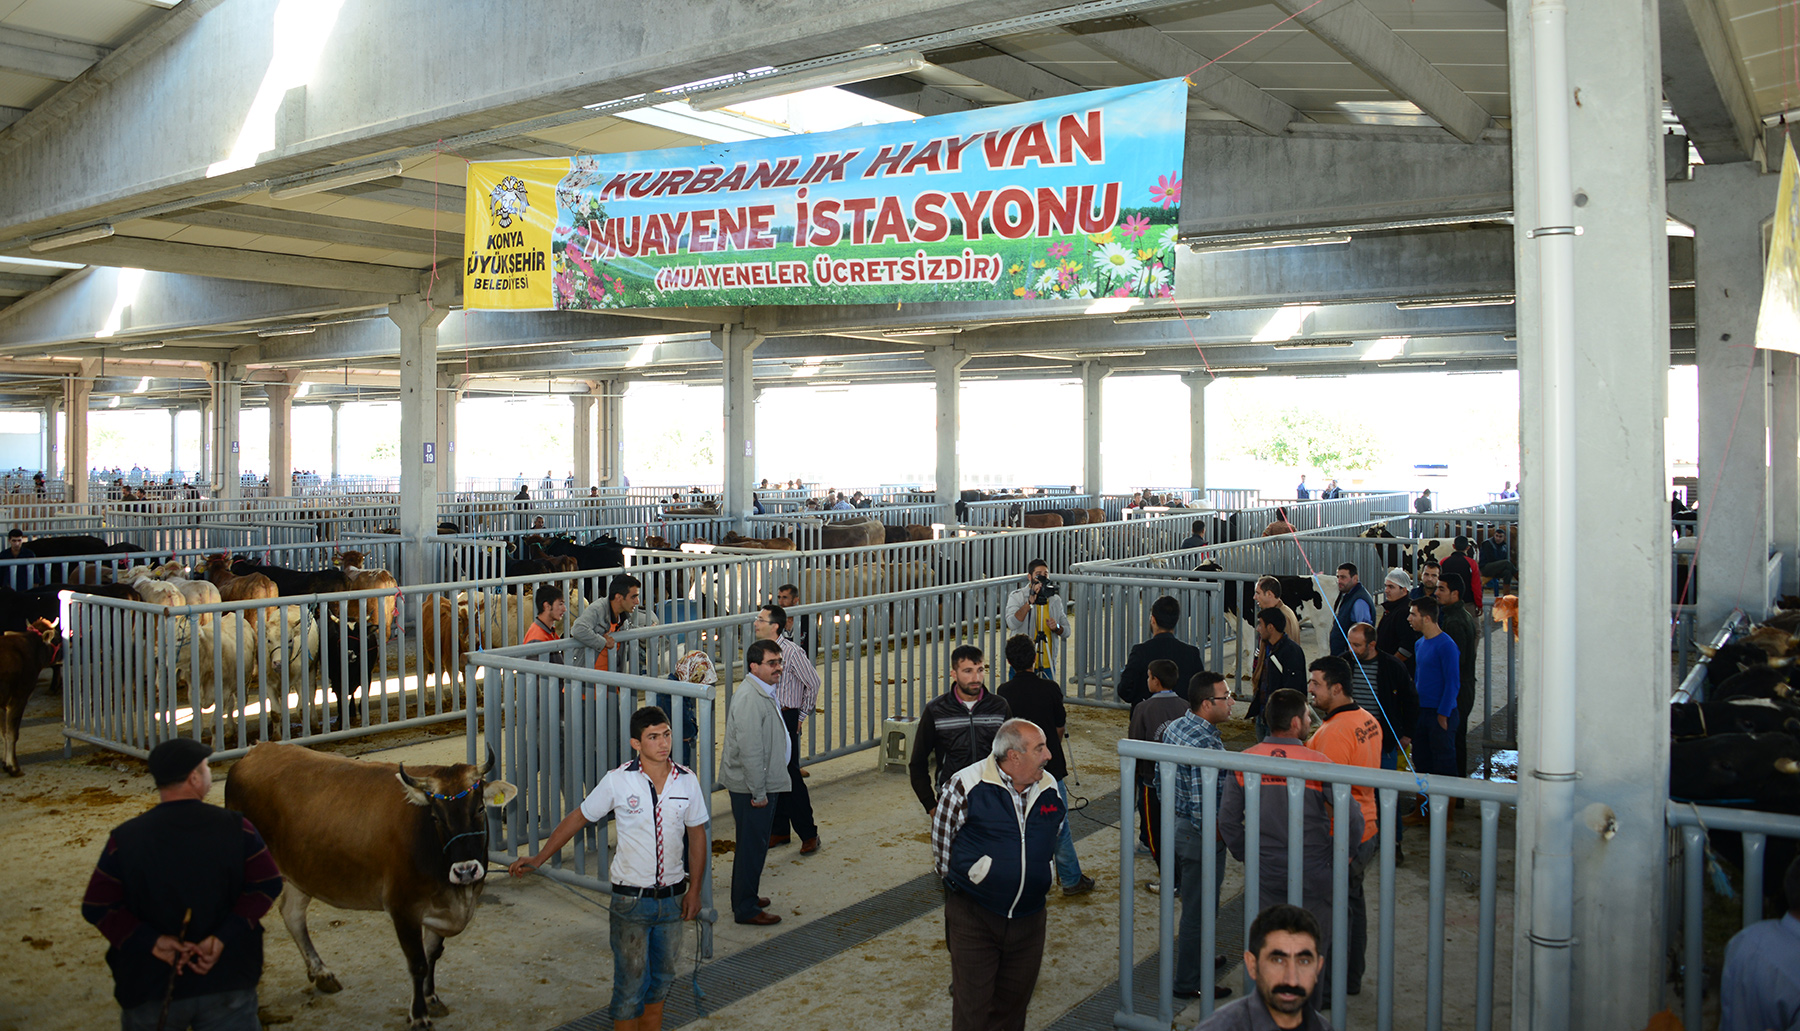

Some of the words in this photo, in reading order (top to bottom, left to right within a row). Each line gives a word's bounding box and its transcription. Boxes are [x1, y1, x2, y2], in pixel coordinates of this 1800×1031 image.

[601, 151, 861, 201] KURBANLIK
[863, 110, 1103, 178] HAYVAN
[585, 204, 776, 258] MUAYENE
[796, 182, 1120, 247] İSTASYONU
[486, 231, 524, 250] KONYA
[656, 264, 808, 292] (MUAYENELER
[815, 250, 1001, 284] ÜCRETSİZDİR)
[474, 274, 529, 290] BELEDİYESİ
[425, 453, 434, 463] 19
[426, 444, 432, 453] D
